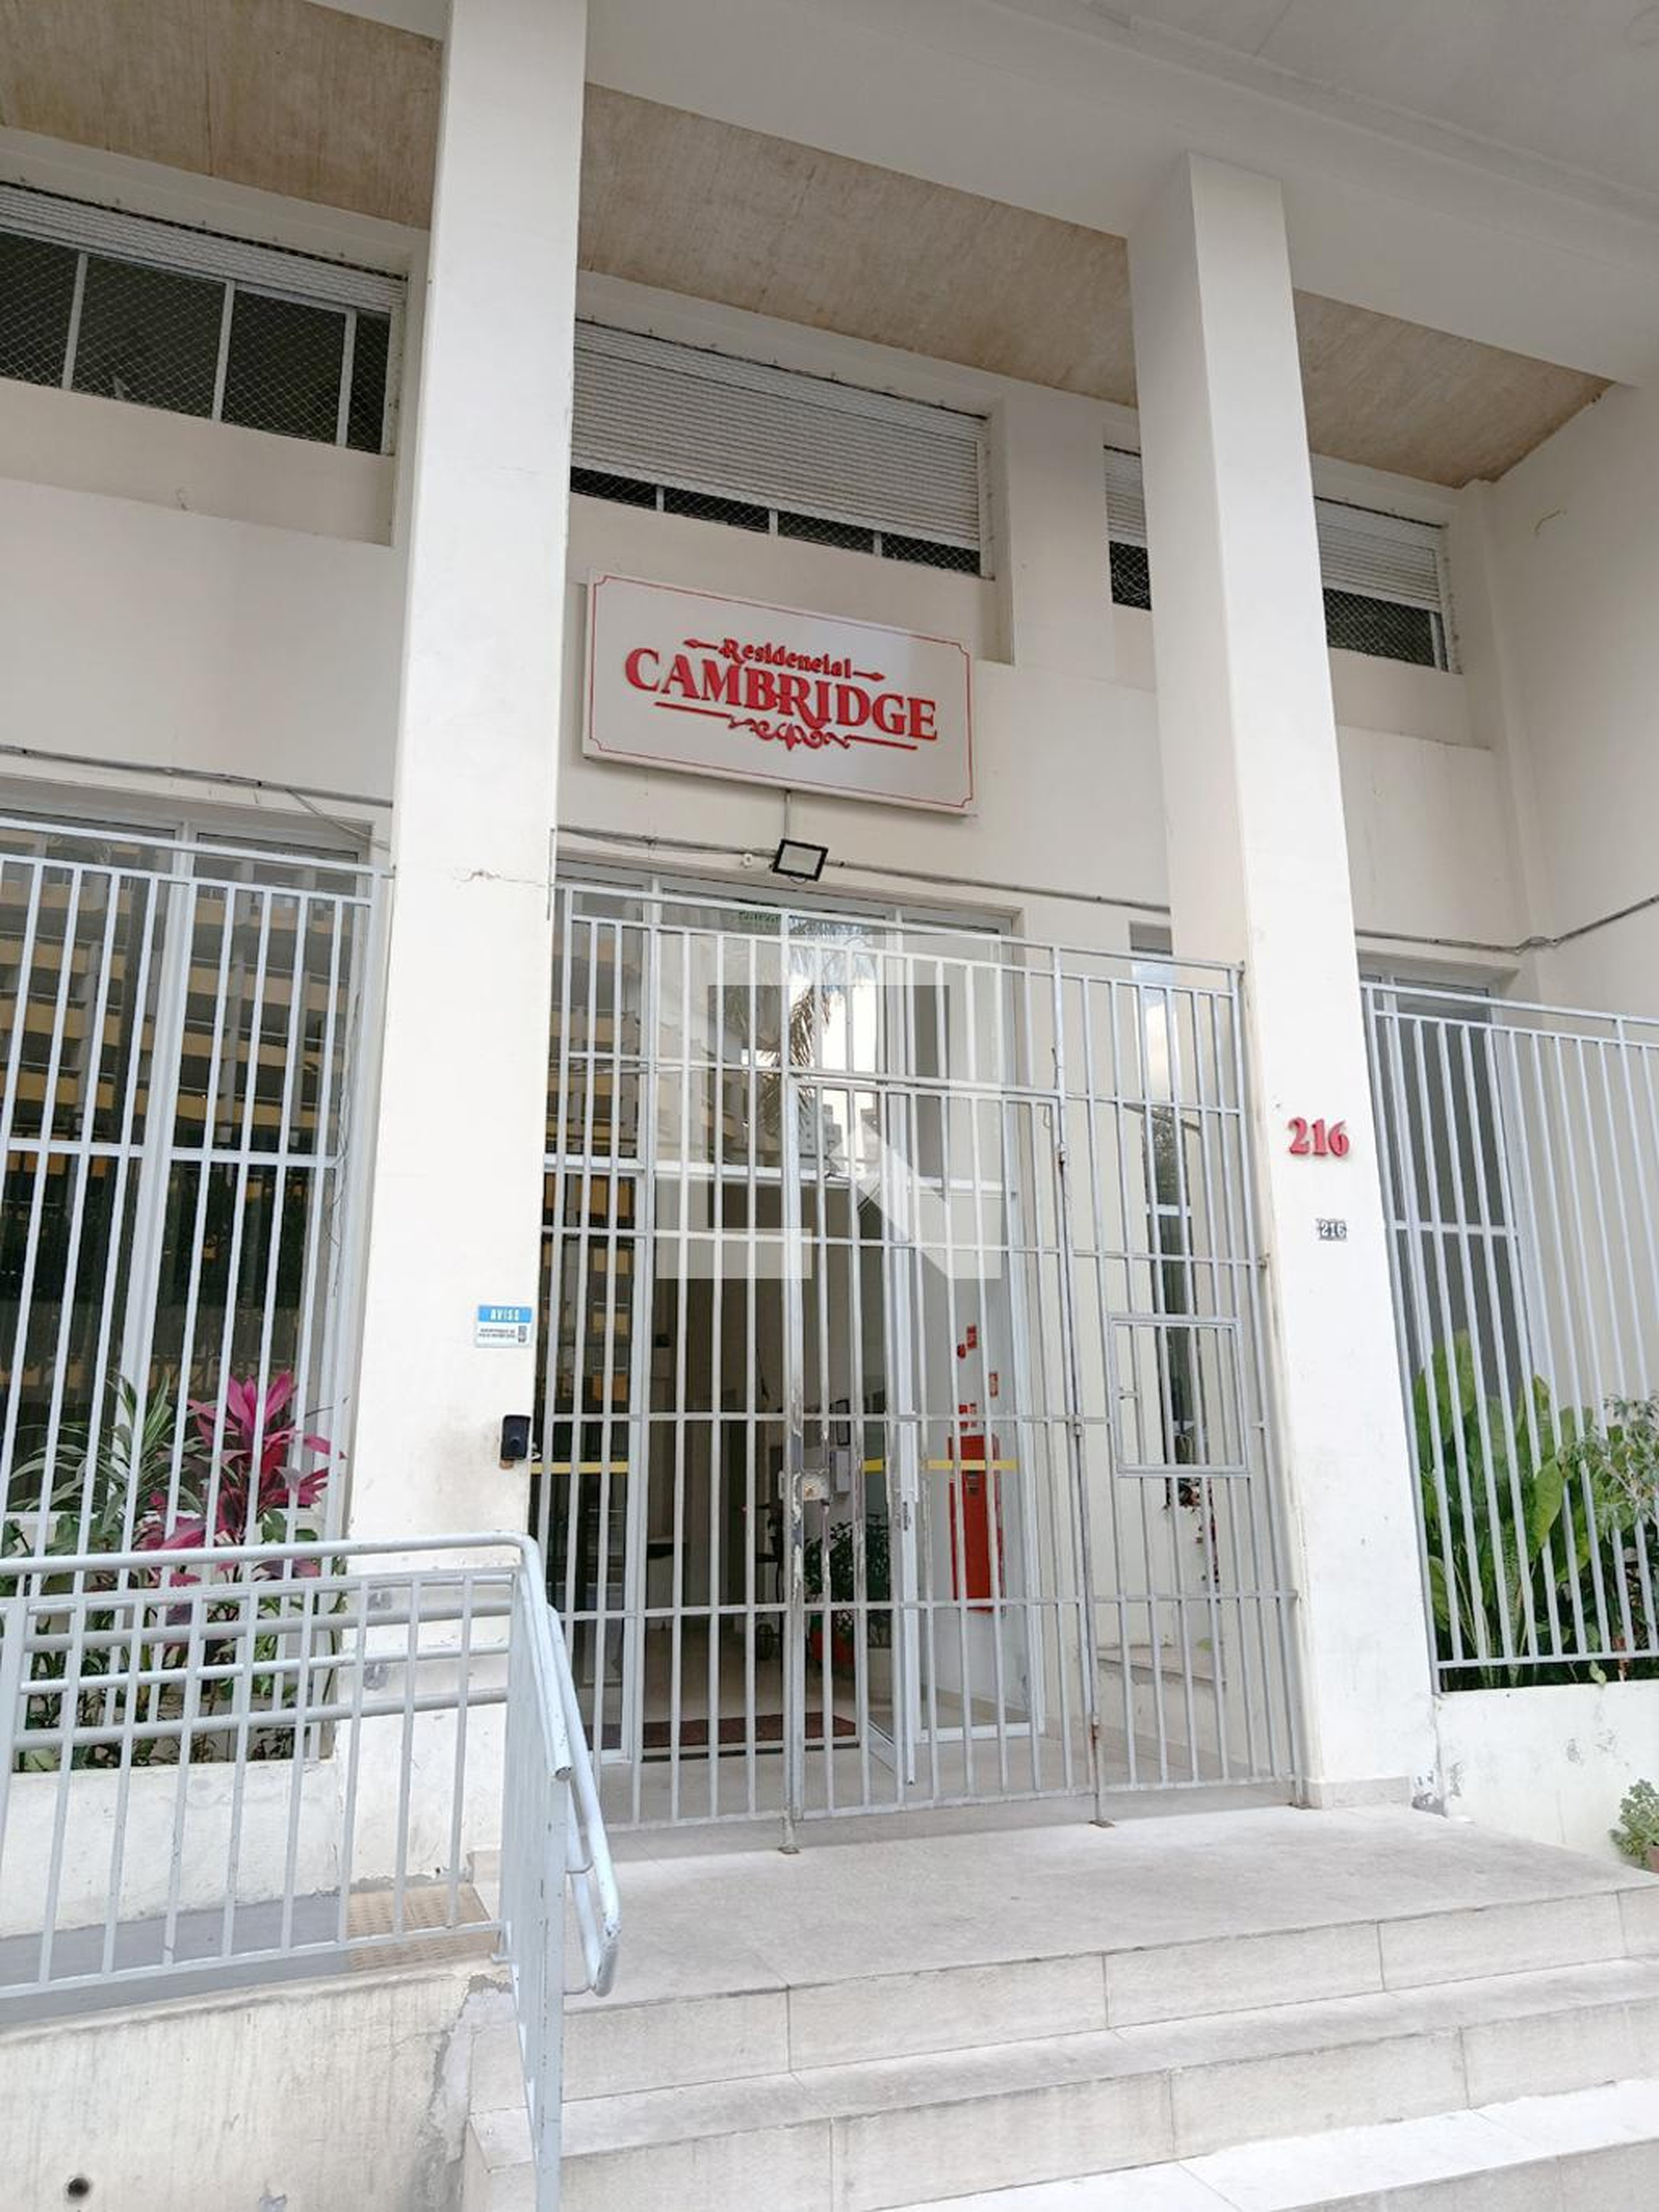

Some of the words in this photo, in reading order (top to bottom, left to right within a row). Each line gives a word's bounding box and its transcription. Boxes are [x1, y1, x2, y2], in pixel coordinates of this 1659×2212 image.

[718, 637, 852, 679] Residencial
[624, 646, 938, 742] CAMBRIDGE
[1288, 1117, 1350, 1157] 216
[1321, 1221, 1346, 1238] 216
